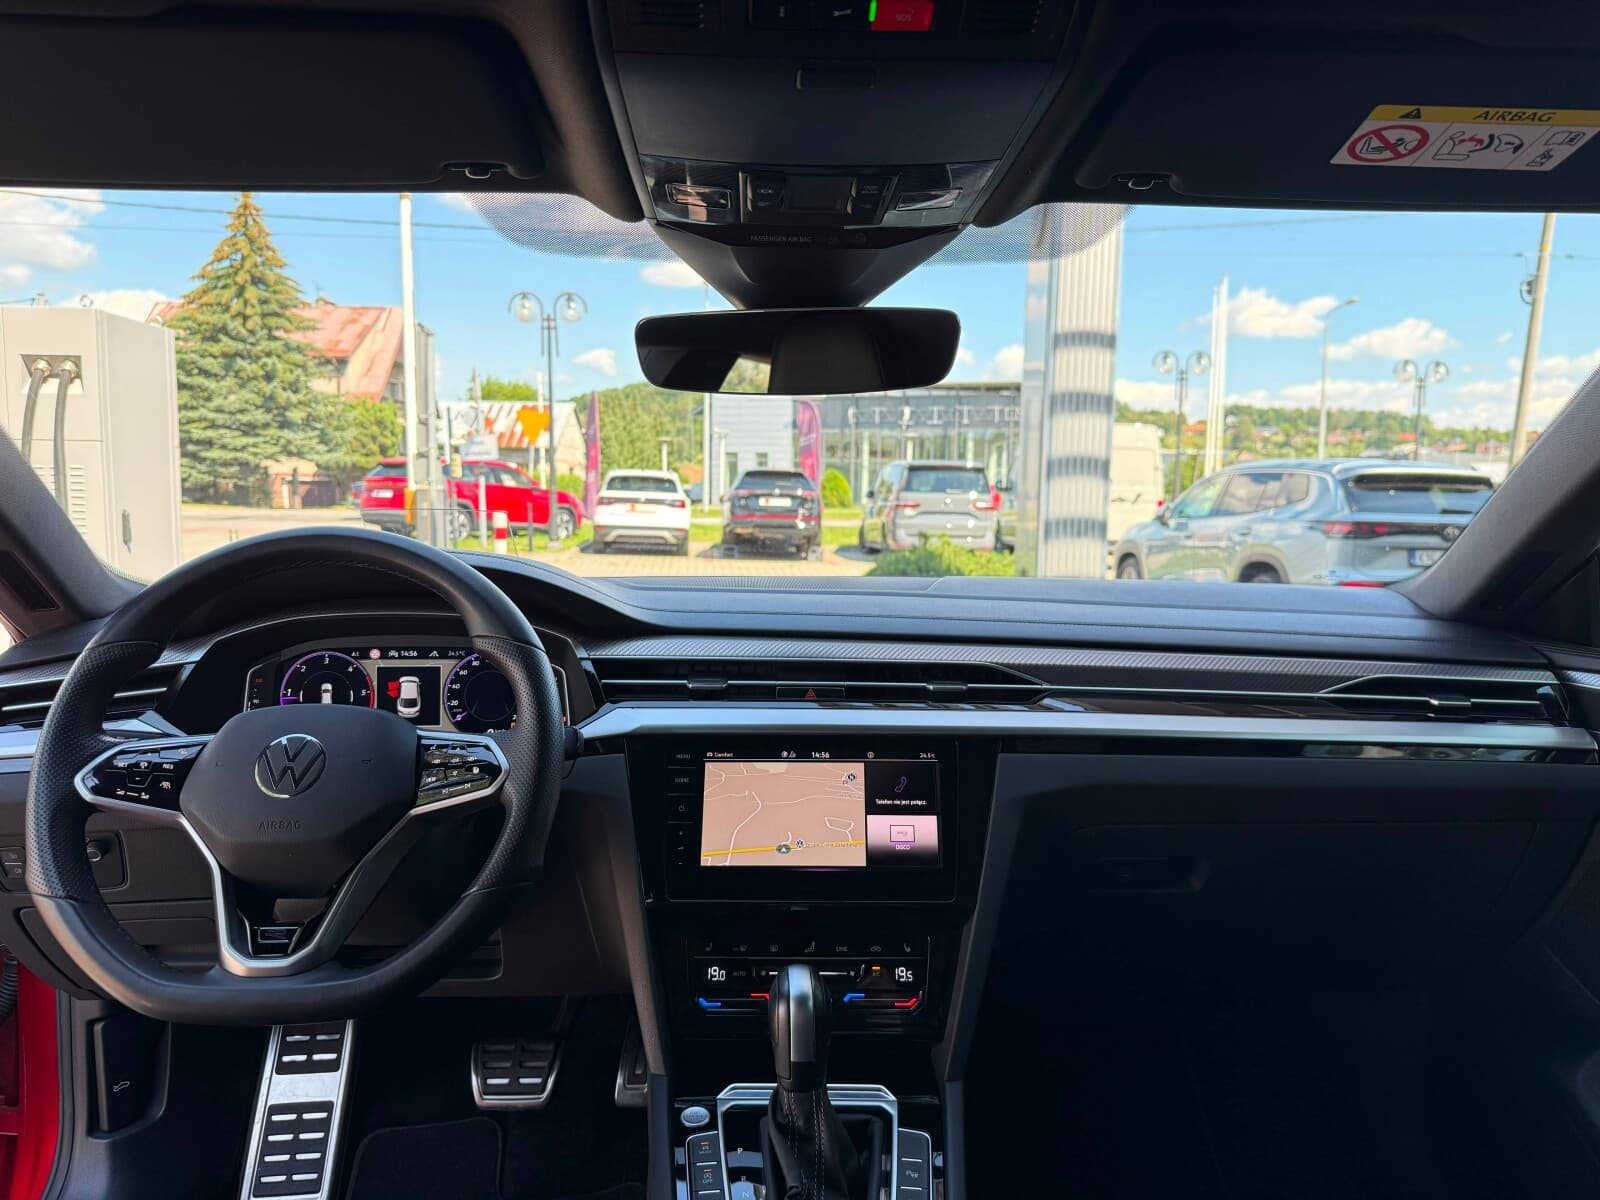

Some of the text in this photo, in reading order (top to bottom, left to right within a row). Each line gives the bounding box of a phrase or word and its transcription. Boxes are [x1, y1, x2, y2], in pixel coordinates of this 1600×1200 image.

[896, 13, 911, 22] SOS
[1474, 110, 1556, 123] AIRBAG
[811, 751, 830, 759] 14:56
[257, 820, 302, 830] AIRBAG
